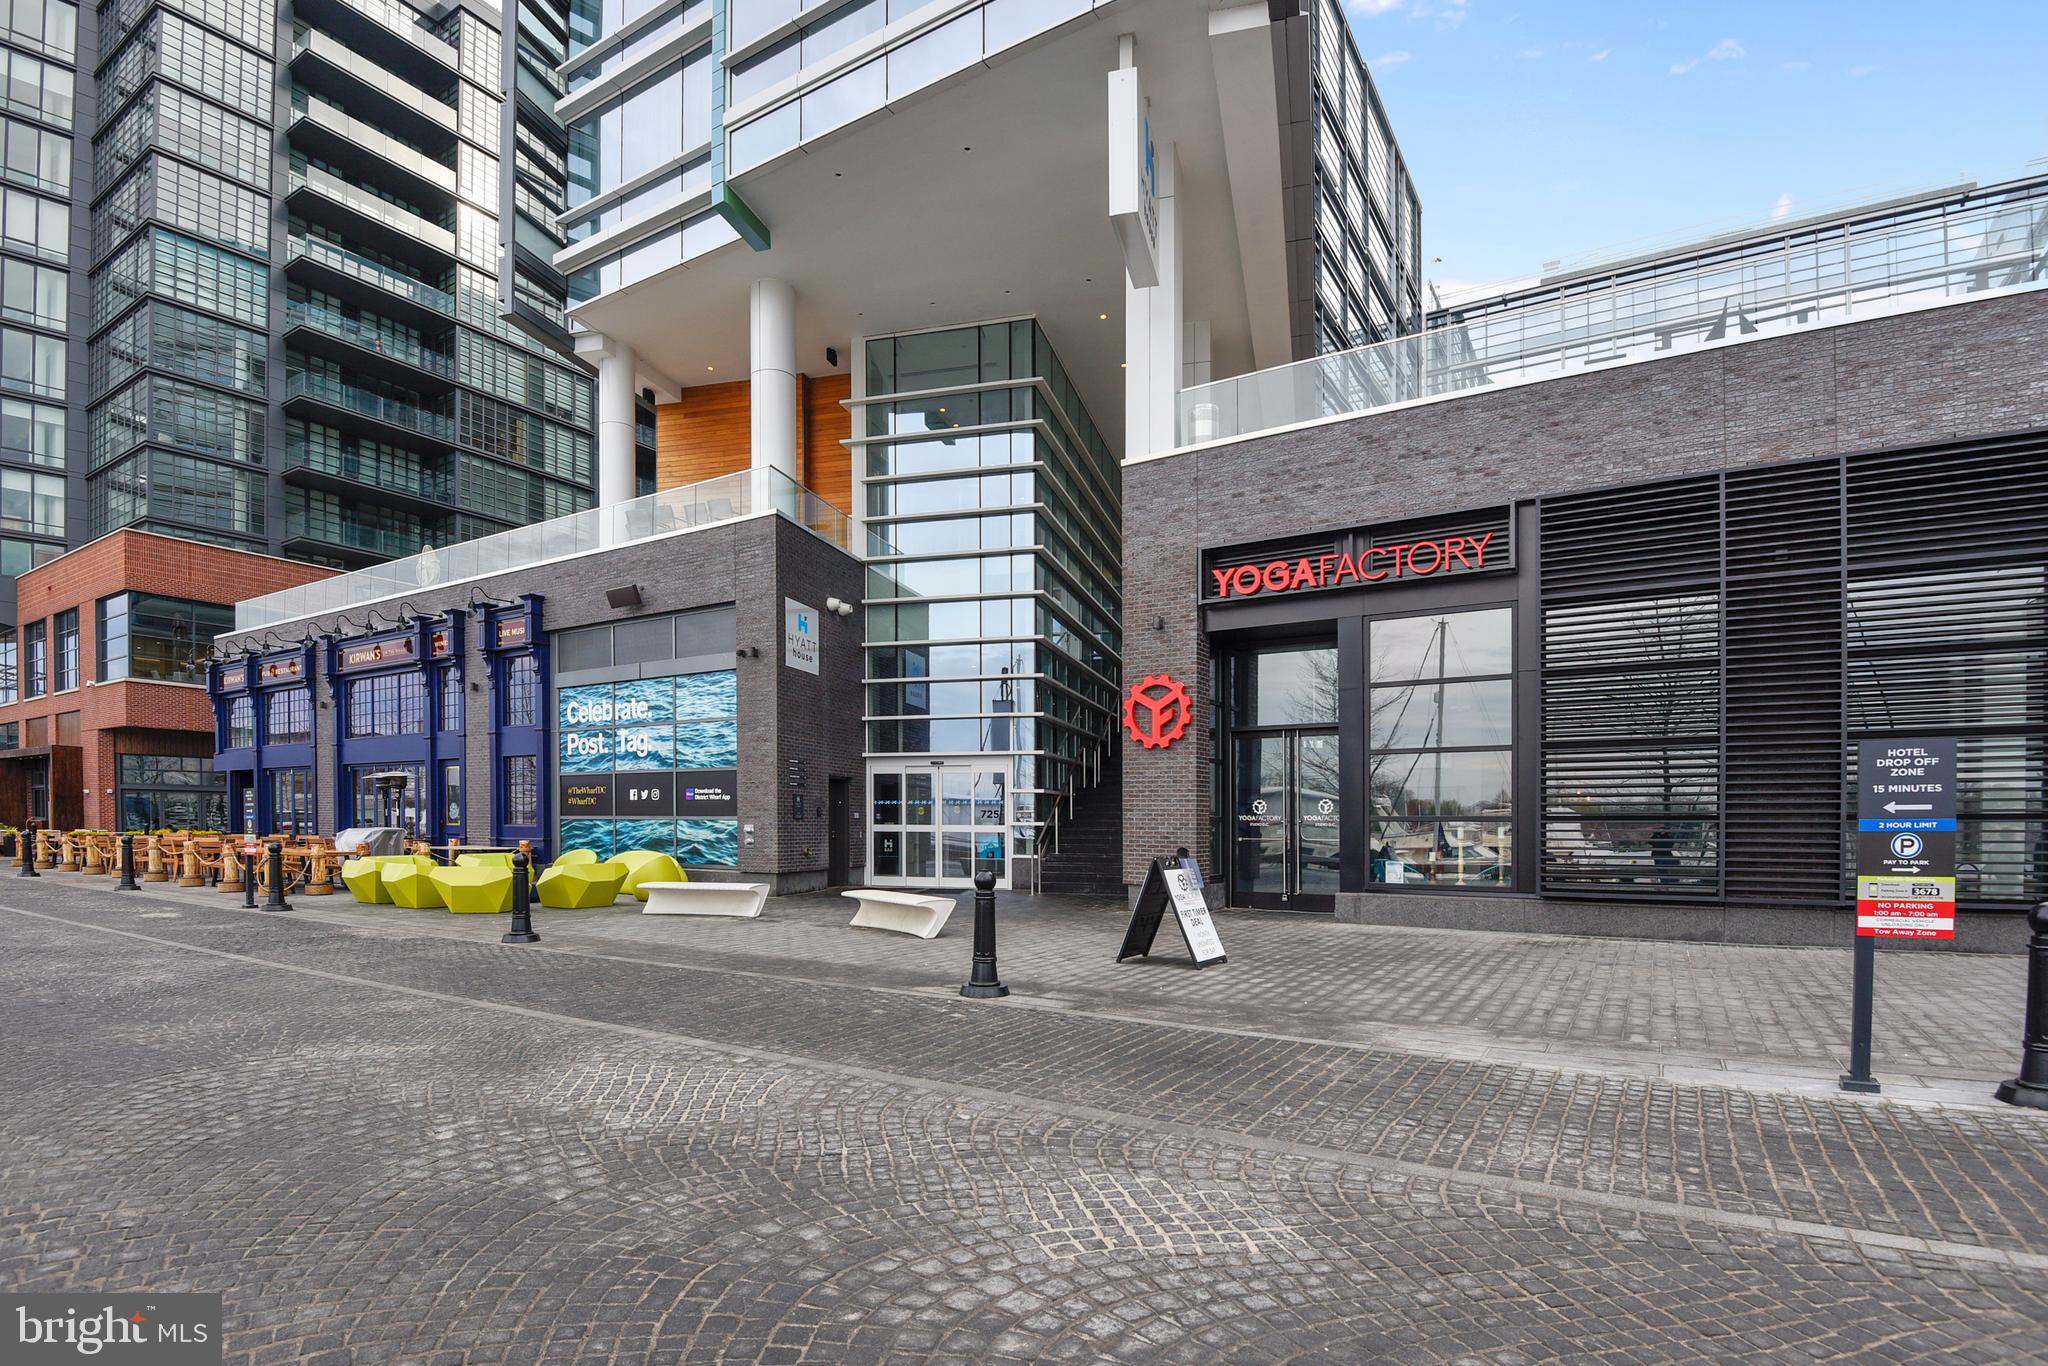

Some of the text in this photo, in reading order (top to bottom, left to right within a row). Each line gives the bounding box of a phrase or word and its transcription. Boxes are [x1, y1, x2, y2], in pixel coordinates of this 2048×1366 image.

[1212, 532, 1495, 598] YOGAFACTORY
[511, 627, 525, 636] MUSI
[788, 632, 816, 652] HYATT
[349, 649, 381, 664] KIRWAN'S
[793, 648, 813, 663] house
[567, 697, 652, 724] Celebrate.
[567, 732, 608, 756] Post.
[1887, 748, 1928, 757] HOTEL
[1876, 758, 1940, 767] DROP OFF
[1890, 768, 1925, 776] ZONE
[567, 786, 607, 795] @TheWharfDC
[1873, 783, 1943, 793] 15 MINUTES
[567, 797, 597, 806] #WharfDC
[981, 810, 1000, 818] 725
[1900, 838, 1915, 853] P
[1180, 908, 1192, 918] FIRST
[1190, 917, 1204, 926] DEAL
